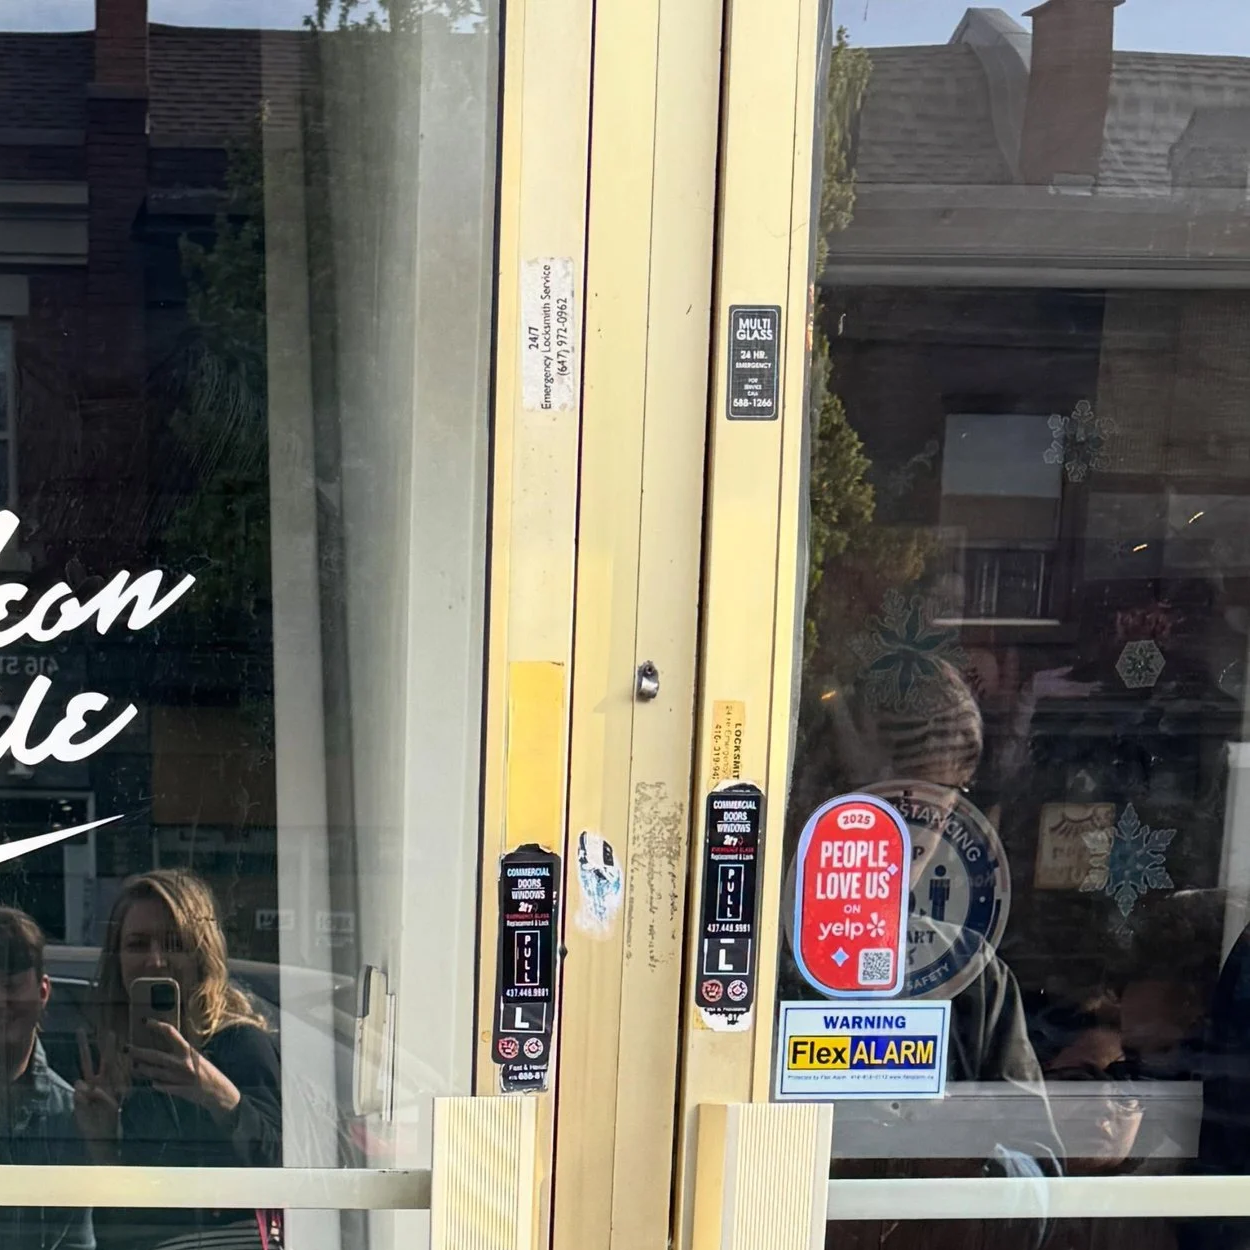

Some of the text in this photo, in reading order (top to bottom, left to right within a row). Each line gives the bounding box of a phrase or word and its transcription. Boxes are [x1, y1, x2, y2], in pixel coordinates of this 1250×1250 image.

[739, 318, 771, 330] MULTI
[529, 326, 539, 350] 24/7
[541, 264, 554, 410] Emergency Locksmith Service
[556, 298, 570, 377] (647) 972-0962
[736, 330, 773, 341] GLASS
[740, 350, 751, 360] 24
[713, 800, 757, 810] COMMERCIAL
[723, 811, 748, 821] DOORS
[842, 813, 871, 825] 2025
[717, 823, 751, 833] WINDOWS
[820, 840, 890, 868] PEOPLE
[507, 867, 550, 877] COMMERCIAL
[518, 879, 542, 888] DOORS
[816, 871, 890, 900] LOVE US
[511, 890, 545, 900] WINDOWS
[843, 904, 861, 914] ON
[817, 918, 864, 941] yelp
[718, 948, 734, 971] L
[514, 1007, 529, 1028] L
[823, 1015, 907, 1029] WARNING
